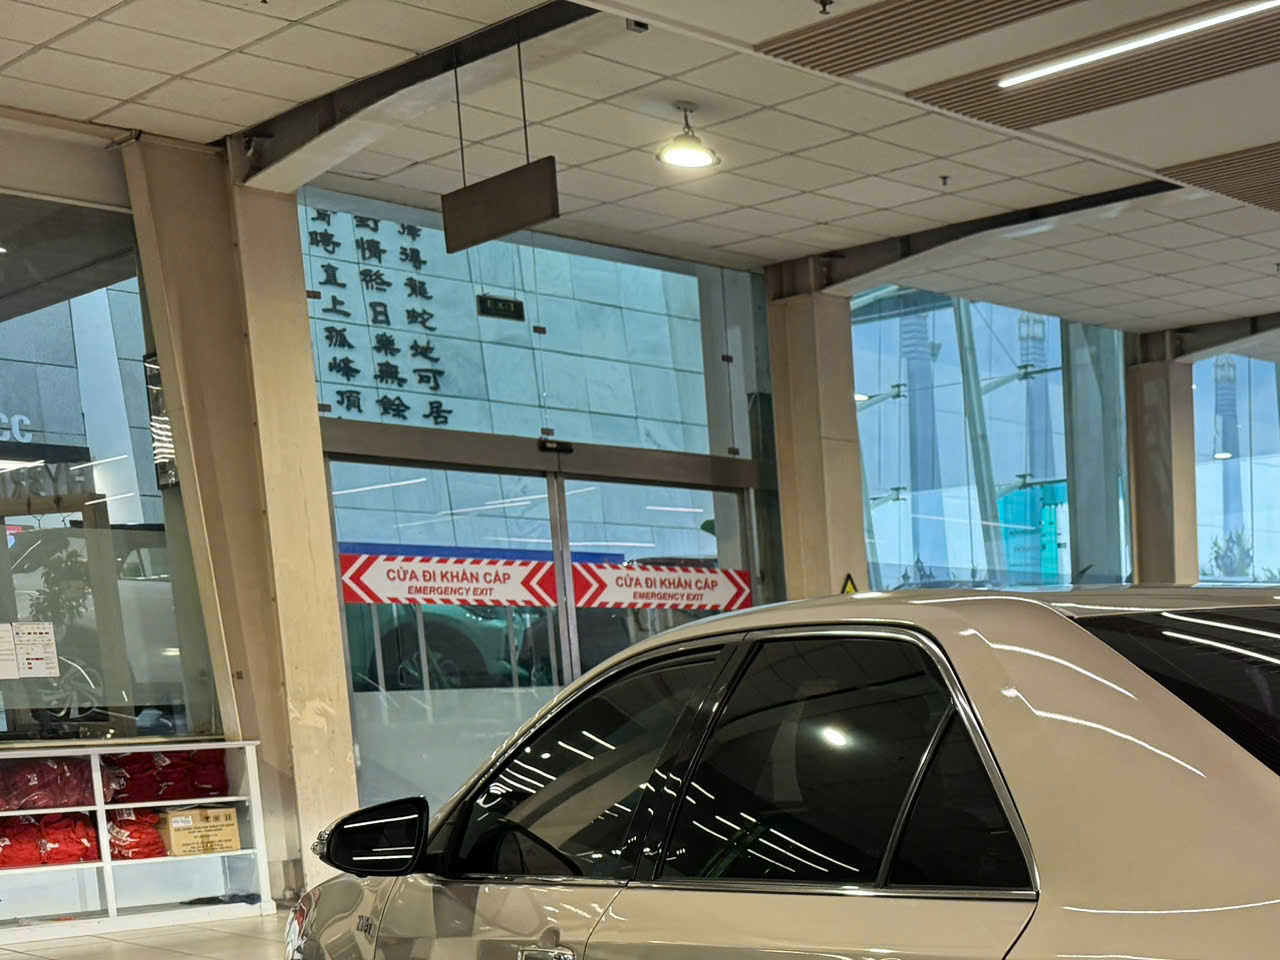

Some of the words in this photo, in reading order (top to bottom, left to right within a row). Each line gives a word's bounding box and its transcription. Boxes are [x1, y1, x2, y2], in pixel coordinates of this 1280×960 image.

[422, 569, 437, 583] ĐI
[644, 577, 657, 589] ĐI
[407, 585, 471, 596] EMERGENCY
[472, 587, 494, 596] EXIT
[633, 591, 685, 601] EMERGENCY
[686, 592, 704, 601] EXIT
